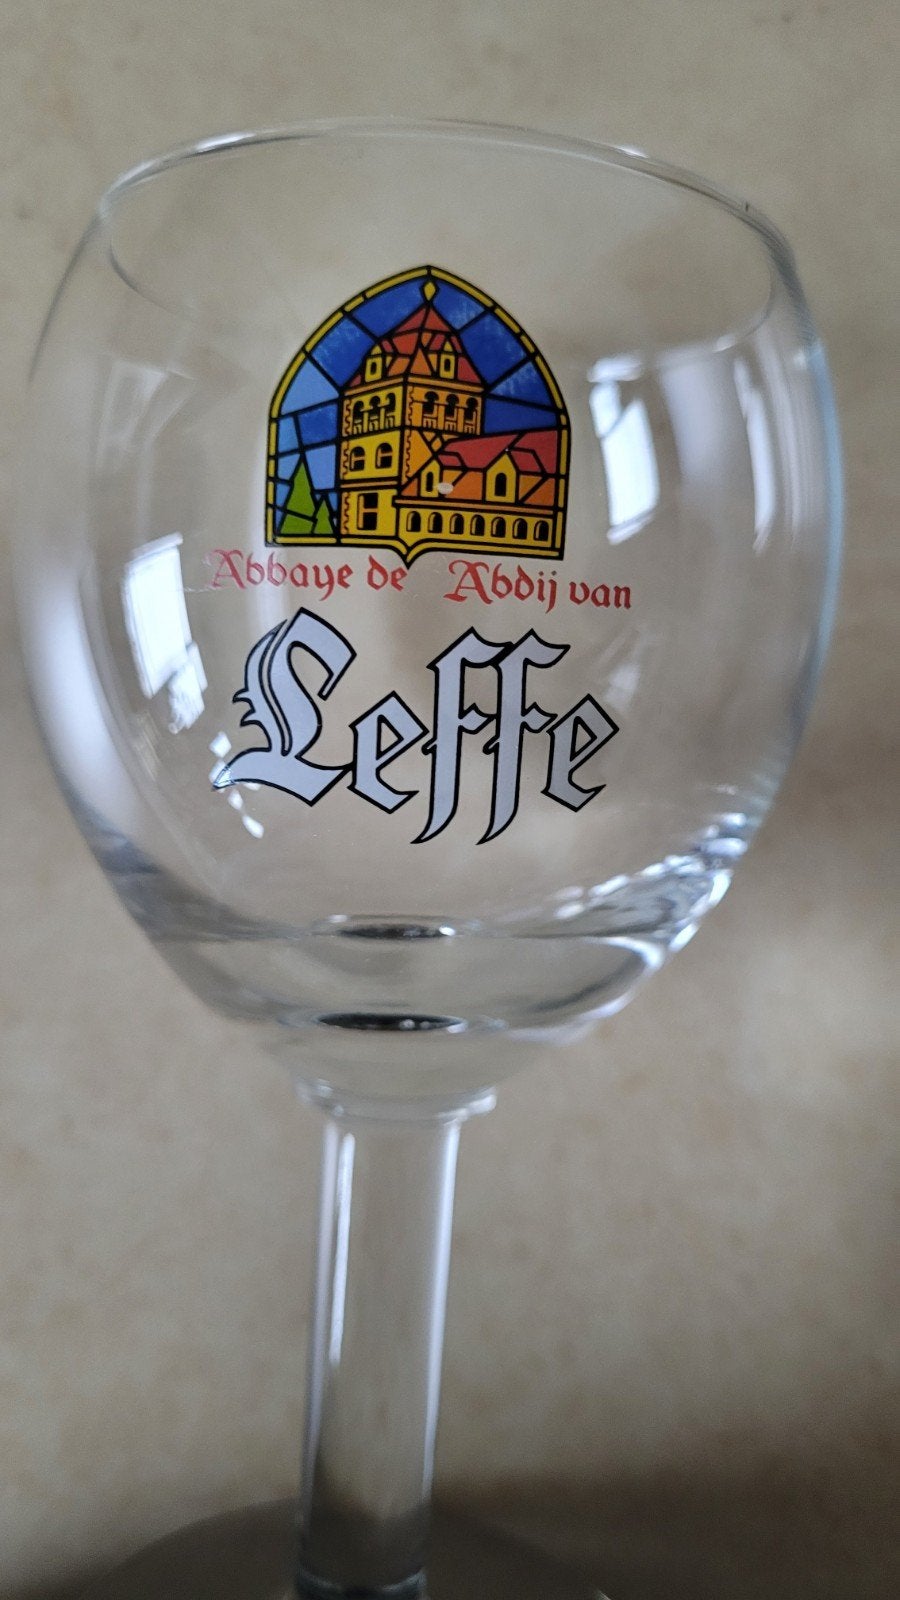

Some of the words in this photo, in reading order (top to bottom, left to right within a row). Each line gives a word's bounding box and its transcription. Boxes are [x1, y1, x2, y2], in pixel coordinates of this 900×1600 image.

[204, 549, 353, 601] Abbaye
[366, 554, 408, 592] de
[443, 559, 558, 613] Abdij
[569, 581, 631, 610] van
[213, 607, 619, 845] Leffe
